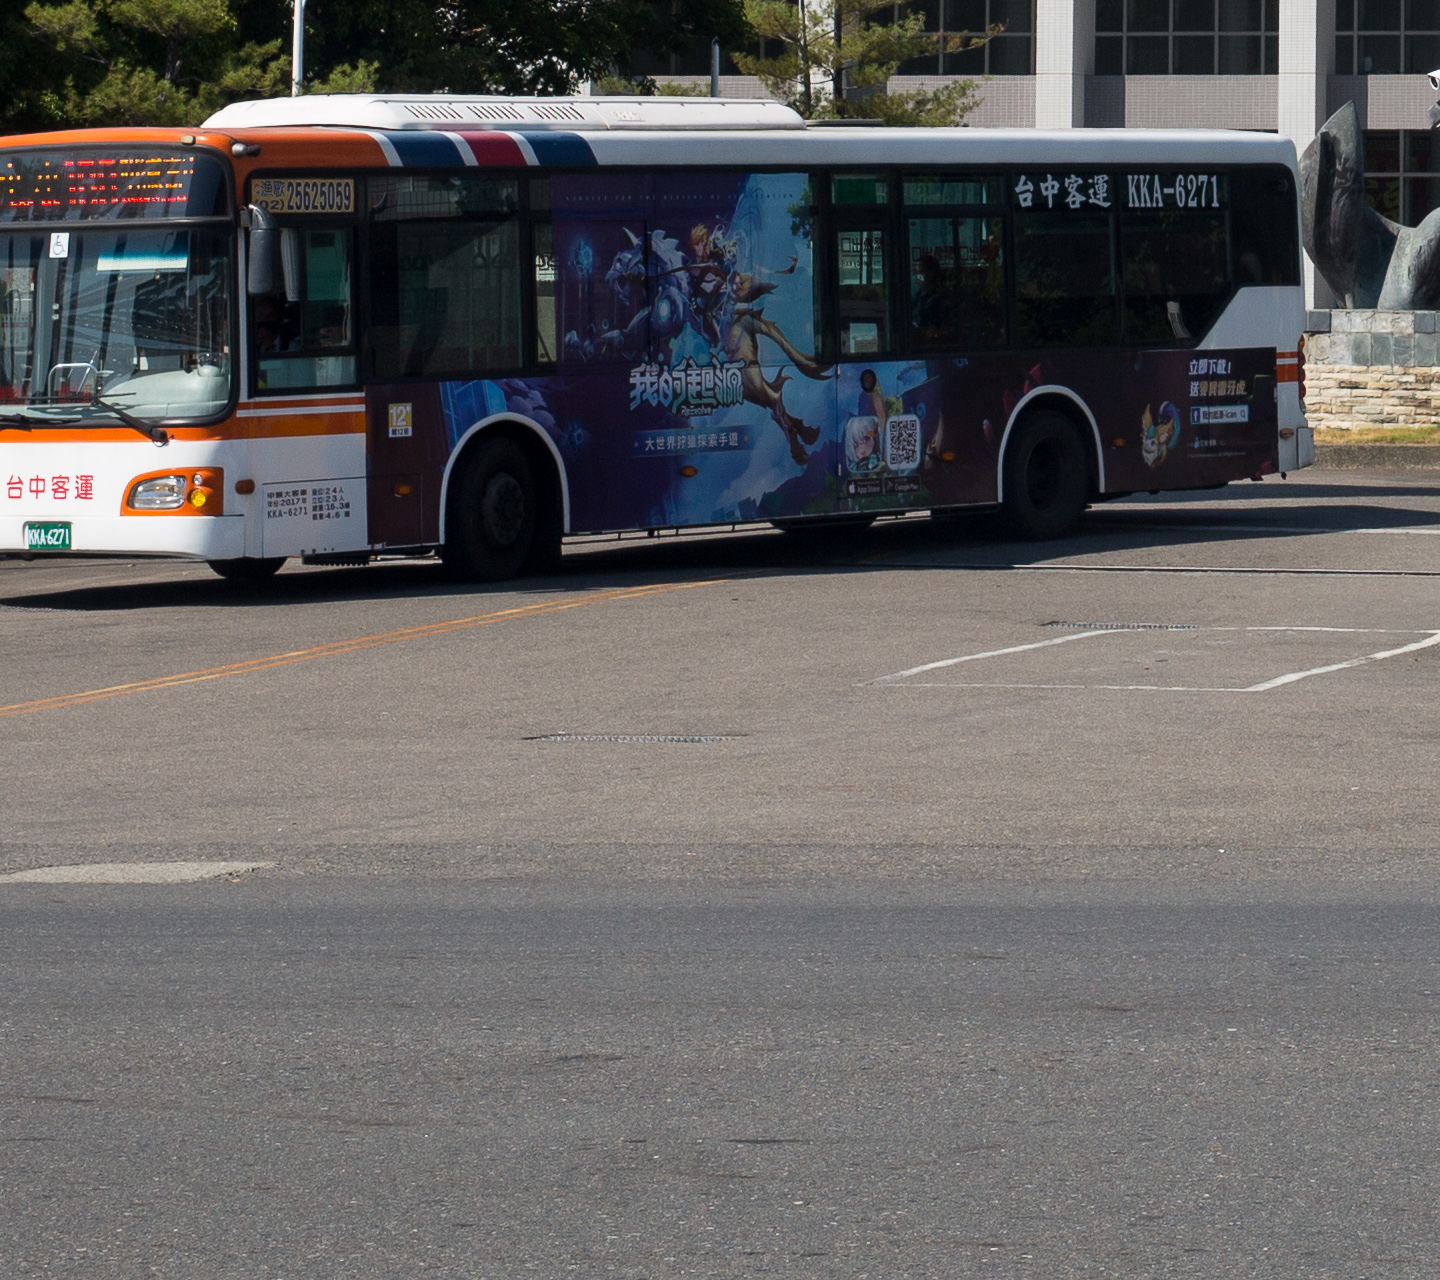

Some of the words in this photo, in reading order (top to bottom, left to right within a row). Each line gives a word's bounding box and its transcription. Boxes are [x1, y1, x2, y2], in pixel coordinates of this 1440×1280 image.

[287, 181, 351, 211] 25625059
[1015, 174, 1111, 209] 台中客運
[1127, 174, 1220, 208] KKA-6271
[629, 357, 745, 414] 我的起源
[7, 474, 93, 500] 台中客運
[267, 507, 308, 519] KKA-6271
[28, 528, 70, 545] KKA-6271
